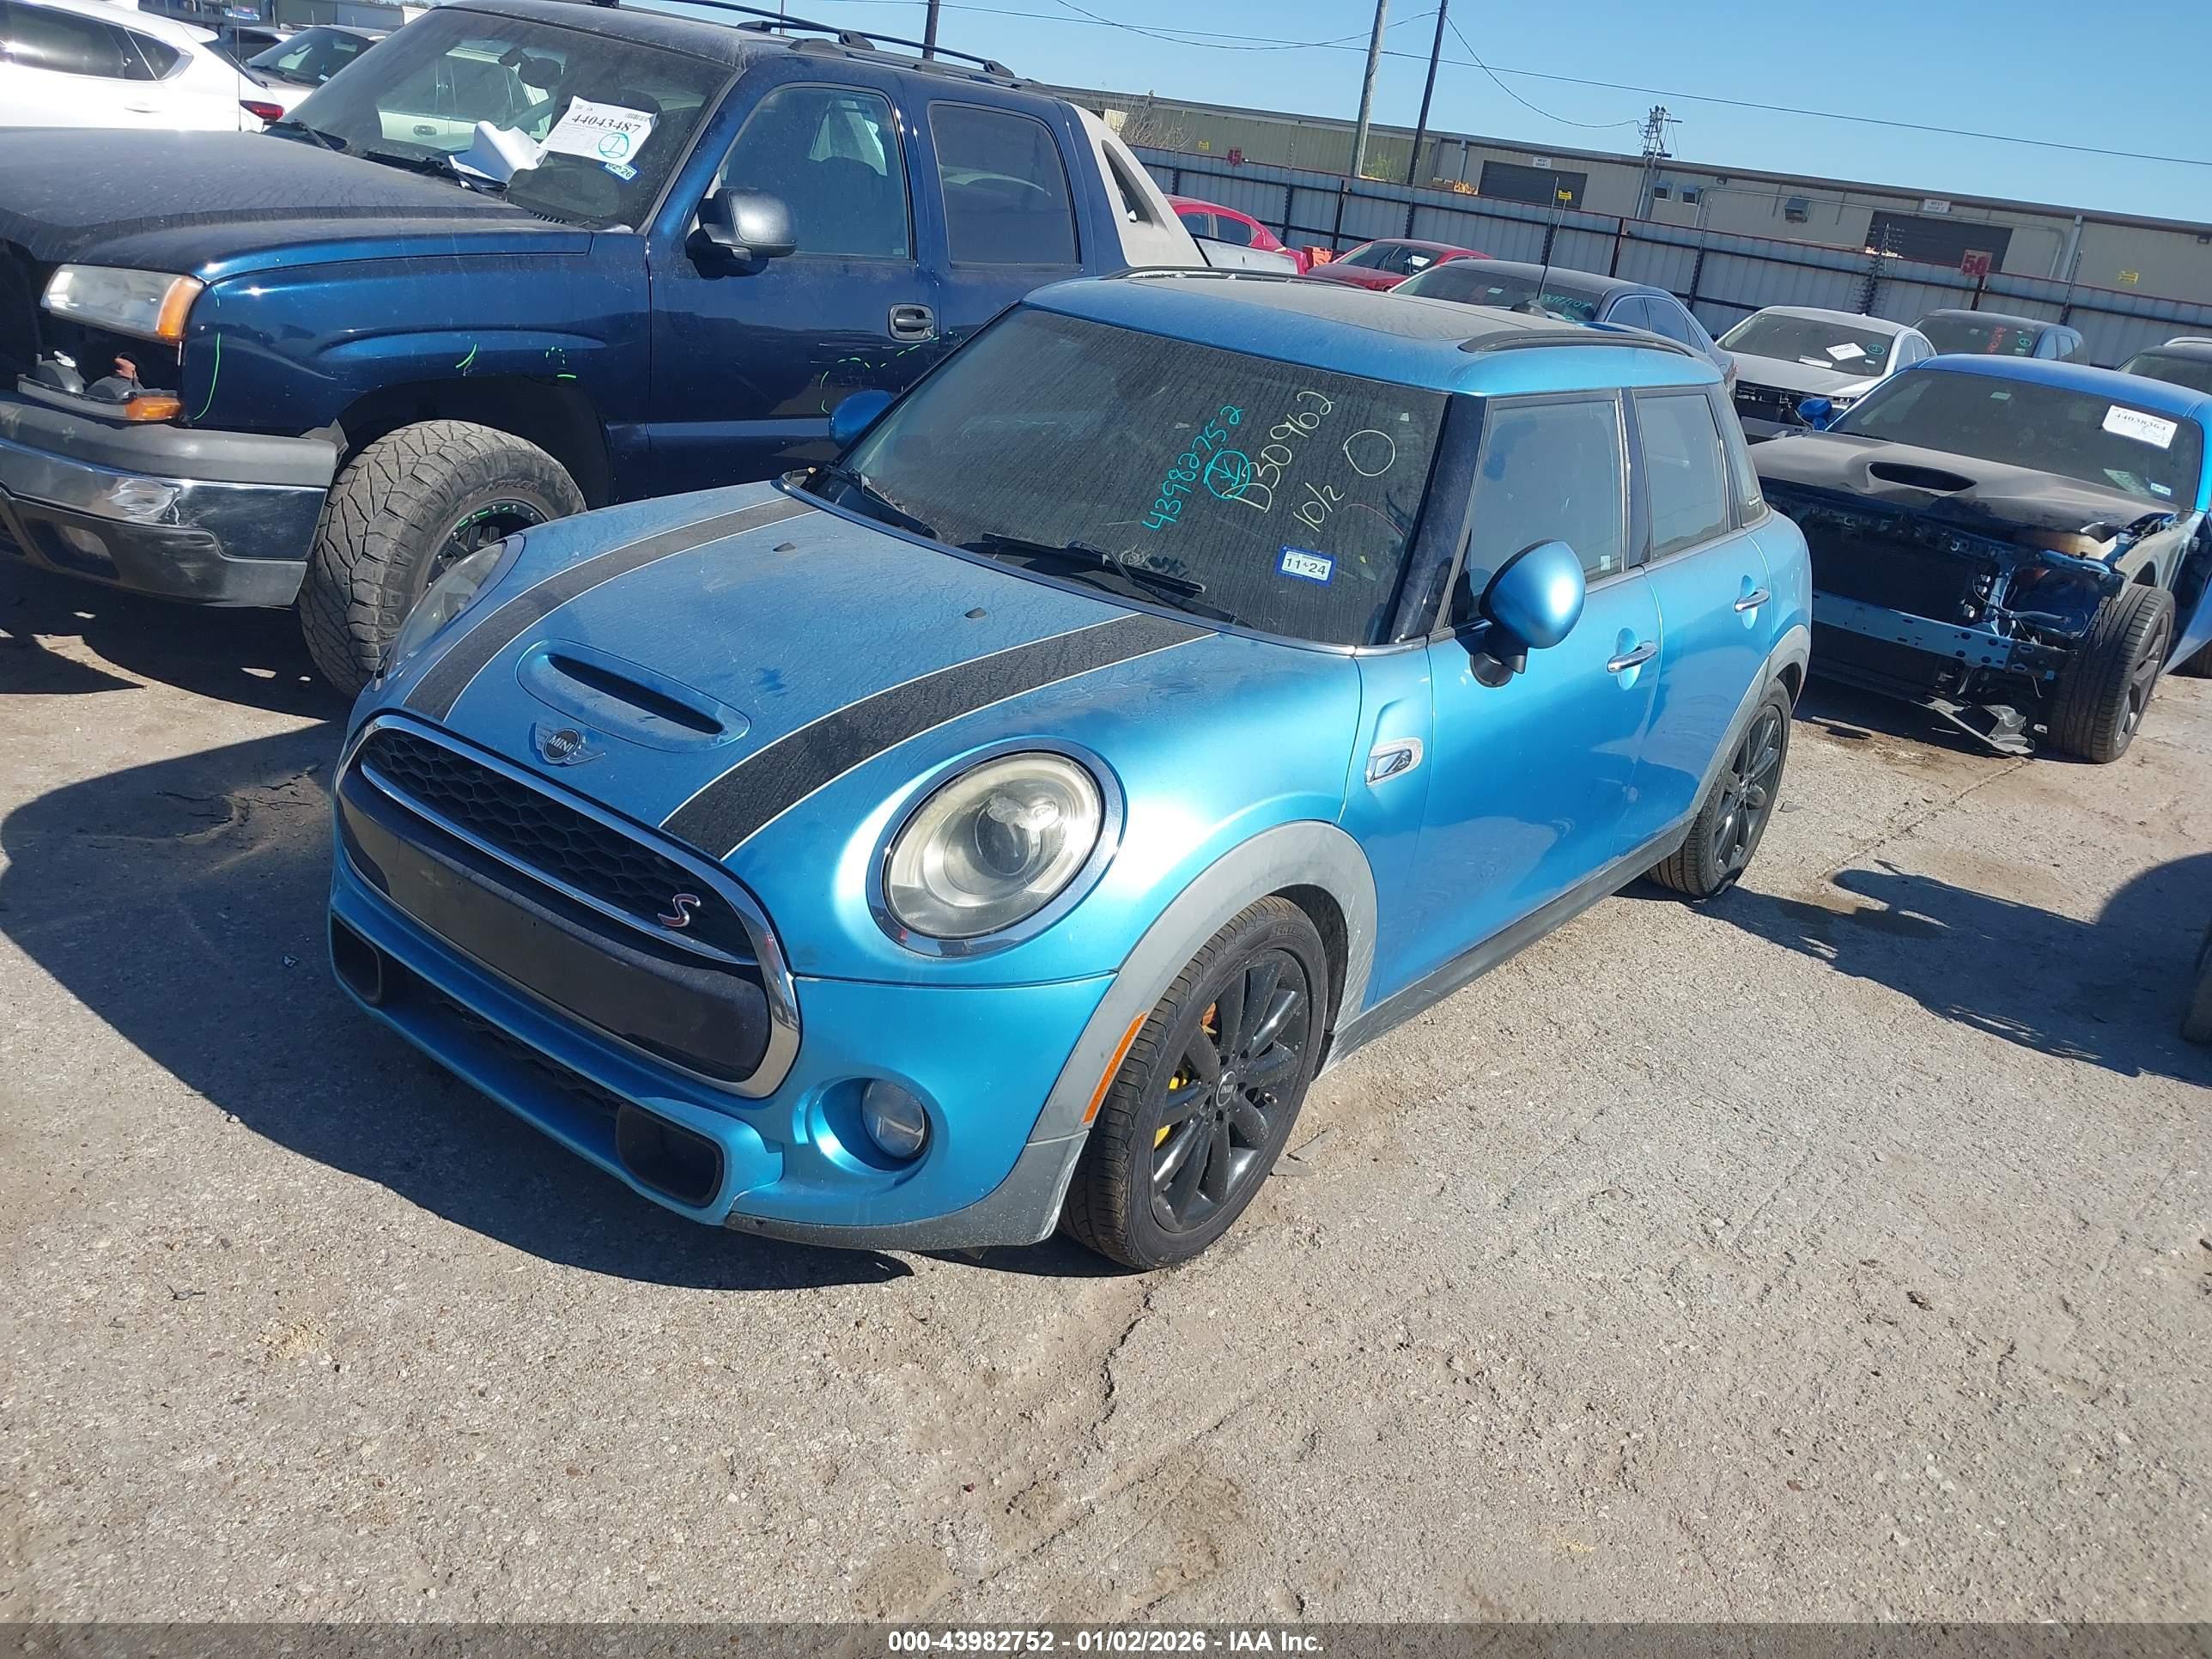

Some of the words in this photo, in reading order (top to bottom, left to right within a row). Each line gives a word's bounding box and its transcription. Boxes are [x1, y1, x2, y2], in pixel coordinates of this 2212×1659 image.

[571, 113, 641, 134] 44043487
[1142, 404, 1244, 530] 43982752
[1291, 481, 1346, 533] 10/2
[549, 734, 574, 752] MINI
[657, 893, 702, 927] S
